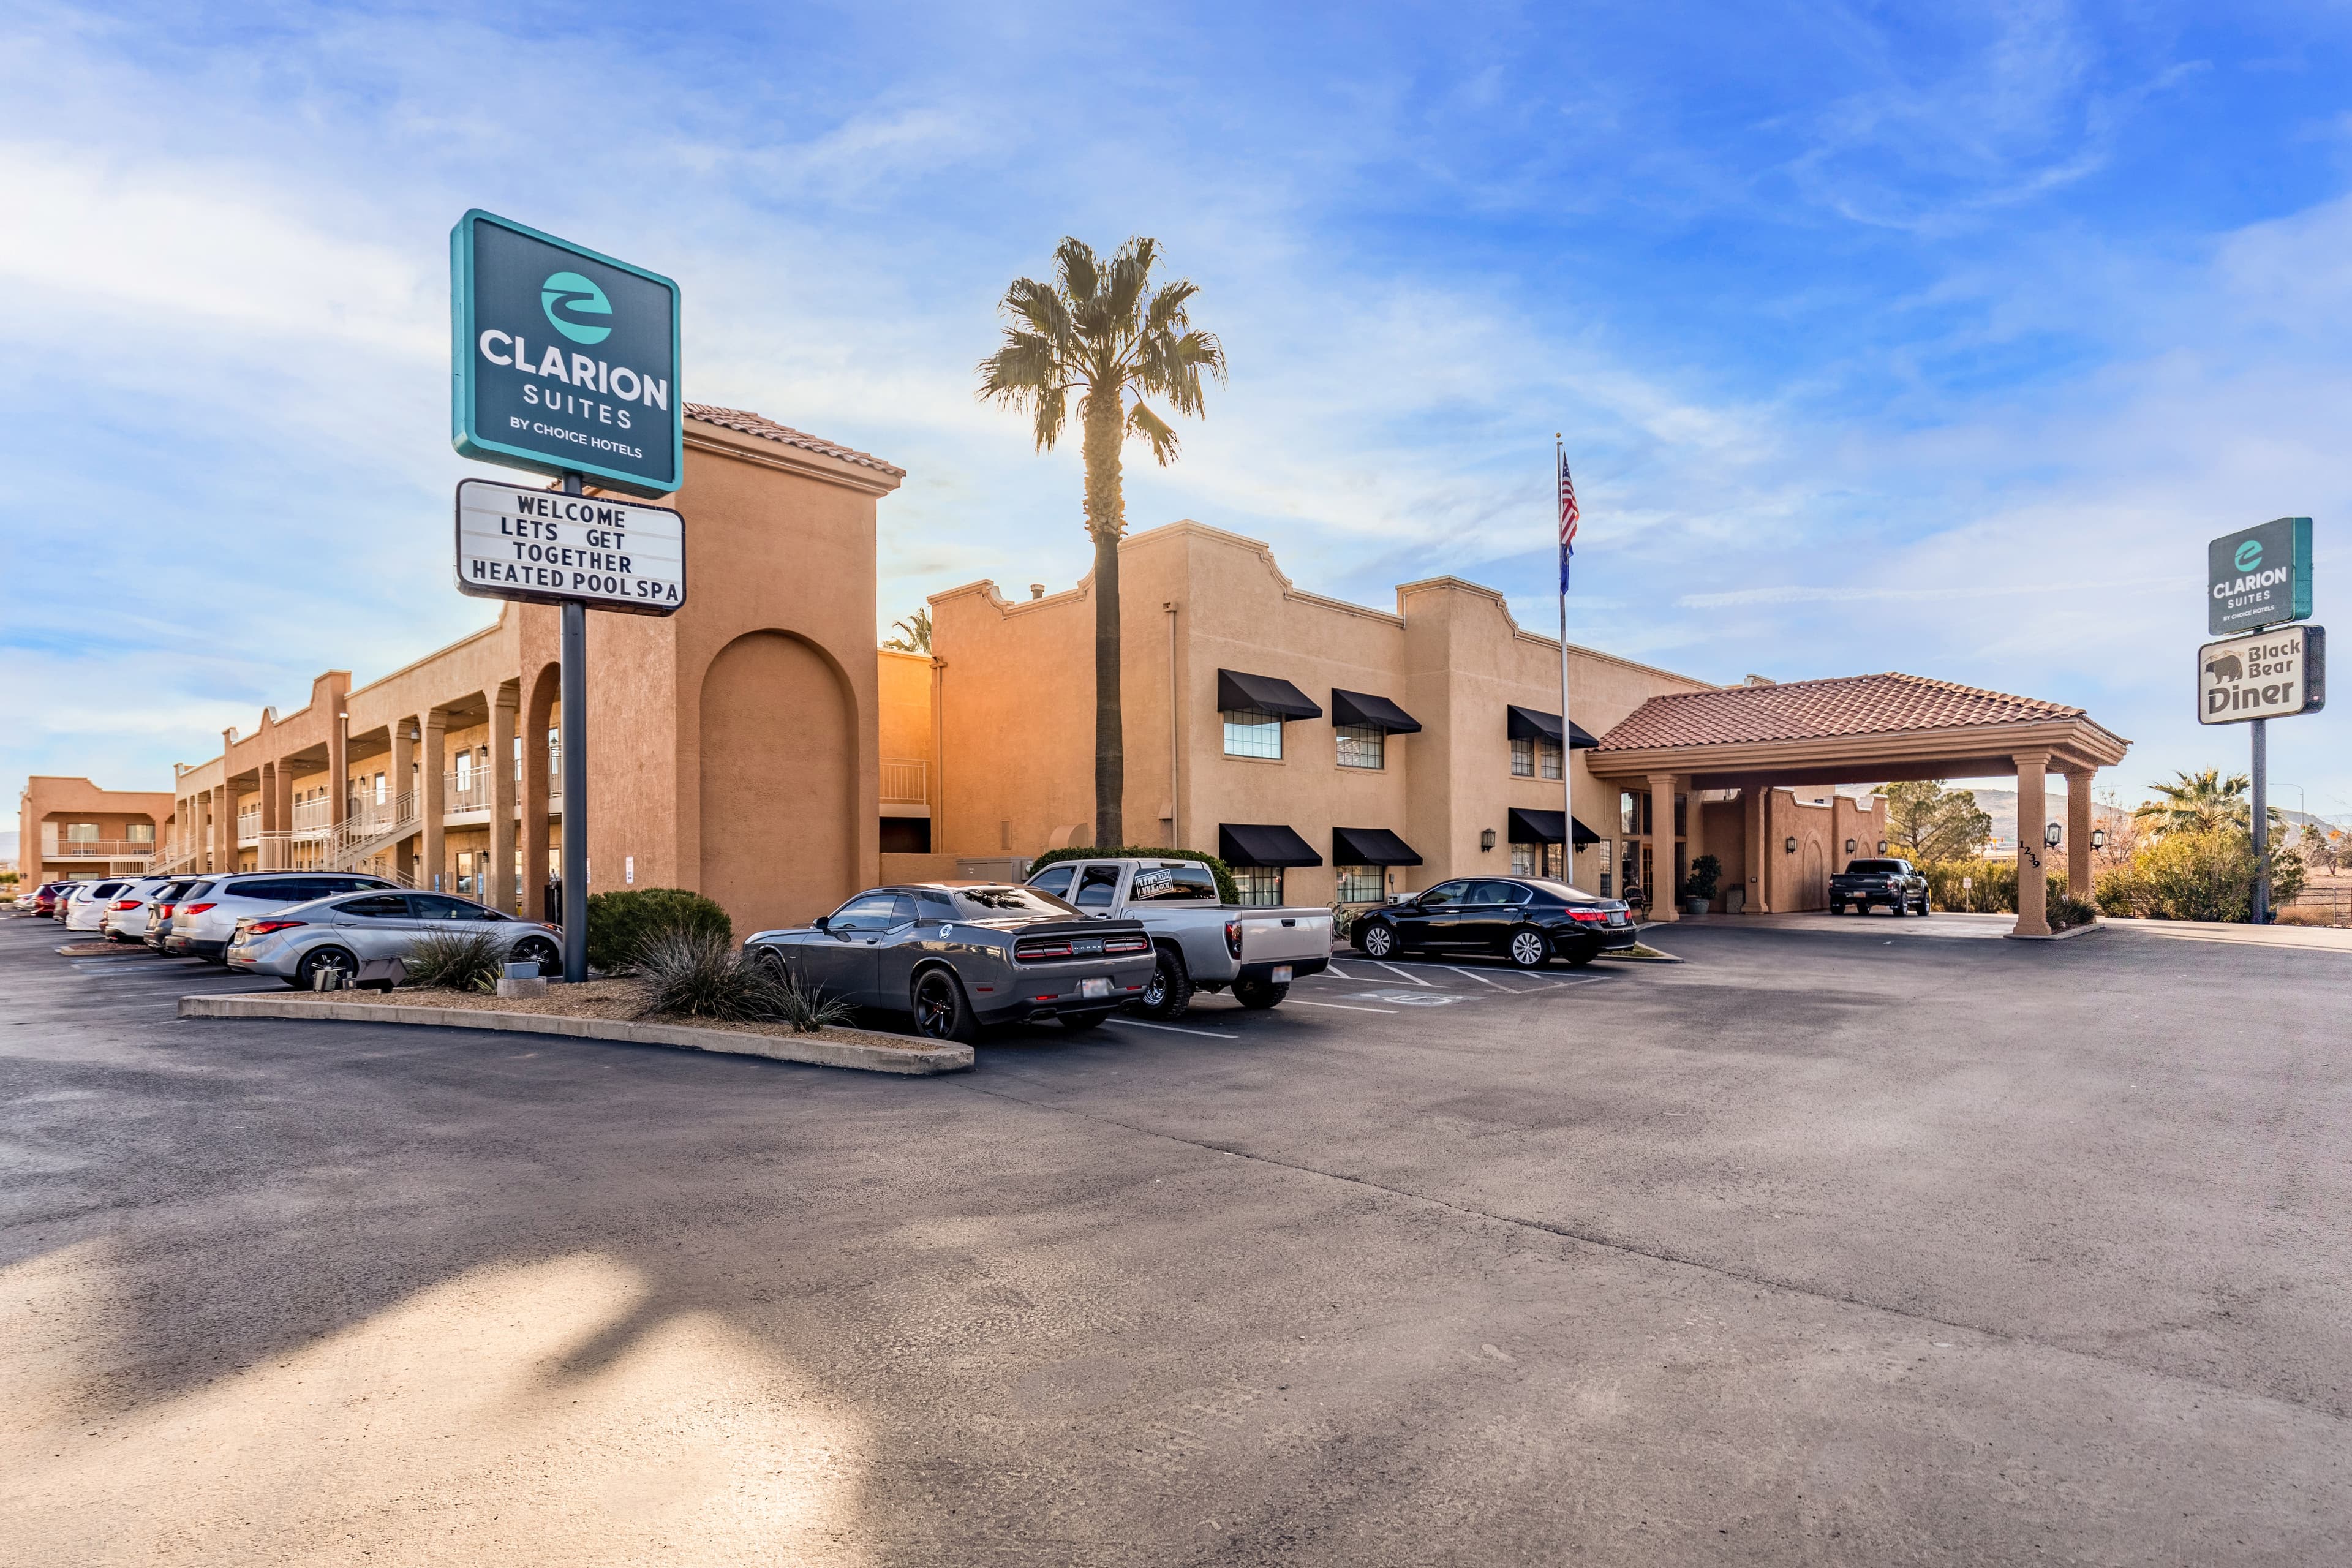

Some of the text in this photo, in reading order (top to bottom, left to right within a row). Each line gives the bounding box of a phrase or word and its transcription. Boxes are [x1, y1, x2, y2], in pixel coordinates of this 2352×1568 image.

[480, 329, 667, 411] CLARION
[523, 384, 631, 429] SUITES
[510, 417, 643, 458] BY CHOICE HOTELS
[518, 495, 625, 528] WELCOME
[501, 517, 625, 550] LETS GET
[513, 541, 631, 573] TOGETHER
[473, 560, 679, 601] HEATED POOL SPA
[2213, 567, 2286, 599] CLARION
[2228, 590, 2270, 608] SUITES
[2231, 610, 2252, 619] CHOICE
[2253, 605, 2275, 614] HOTELS
[2248, 639, 2301, 662] Black
[2248, 660, 2293, 679] Bear
[2208, 681, 2294, 714] Diner
[2019, 840, 2040, 868] 1239
